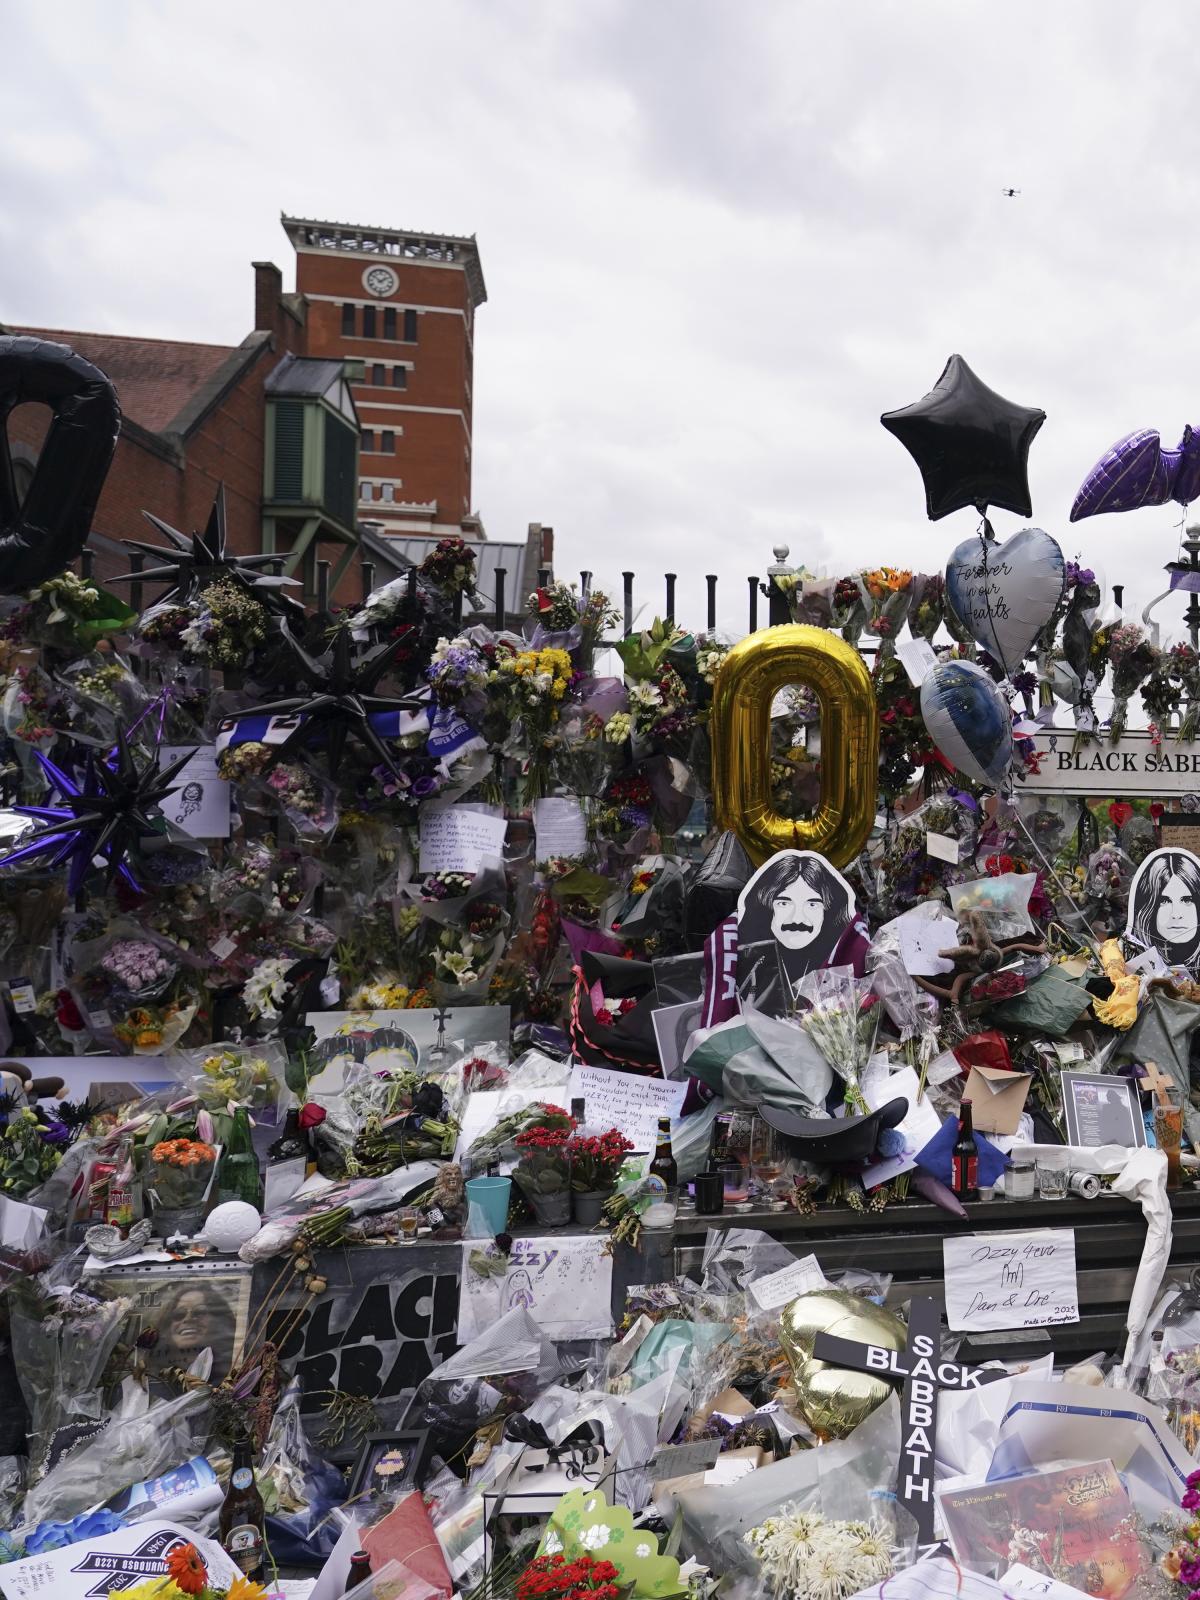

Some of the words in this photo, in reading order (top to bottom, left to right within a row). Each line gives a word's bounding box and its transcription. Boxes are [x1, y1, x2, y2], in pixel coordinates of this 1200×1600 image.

[956, 561, 1013, 584] Forever
[963, 596, 1012, 622] Hearts
[432, 733, 450, 747] SUPER
[1057, 751, 1138, 772] BLACK
[581, 1071, 611, 1085] Without
[971, 1246, 1019, 1266] Ozzy
[1023, 1242, 1058, 1259] 4ever
[963, 1291, 998, 1320] Dan
[1003, 1293, 1020, 1307] &
[1054, 1306, 1076, 1315] 2025
[866, 1345, 986, 1388] BLACK
[904, 1335, 937, 1502] SABBATH
[952, 1498, 965, 1509] The
